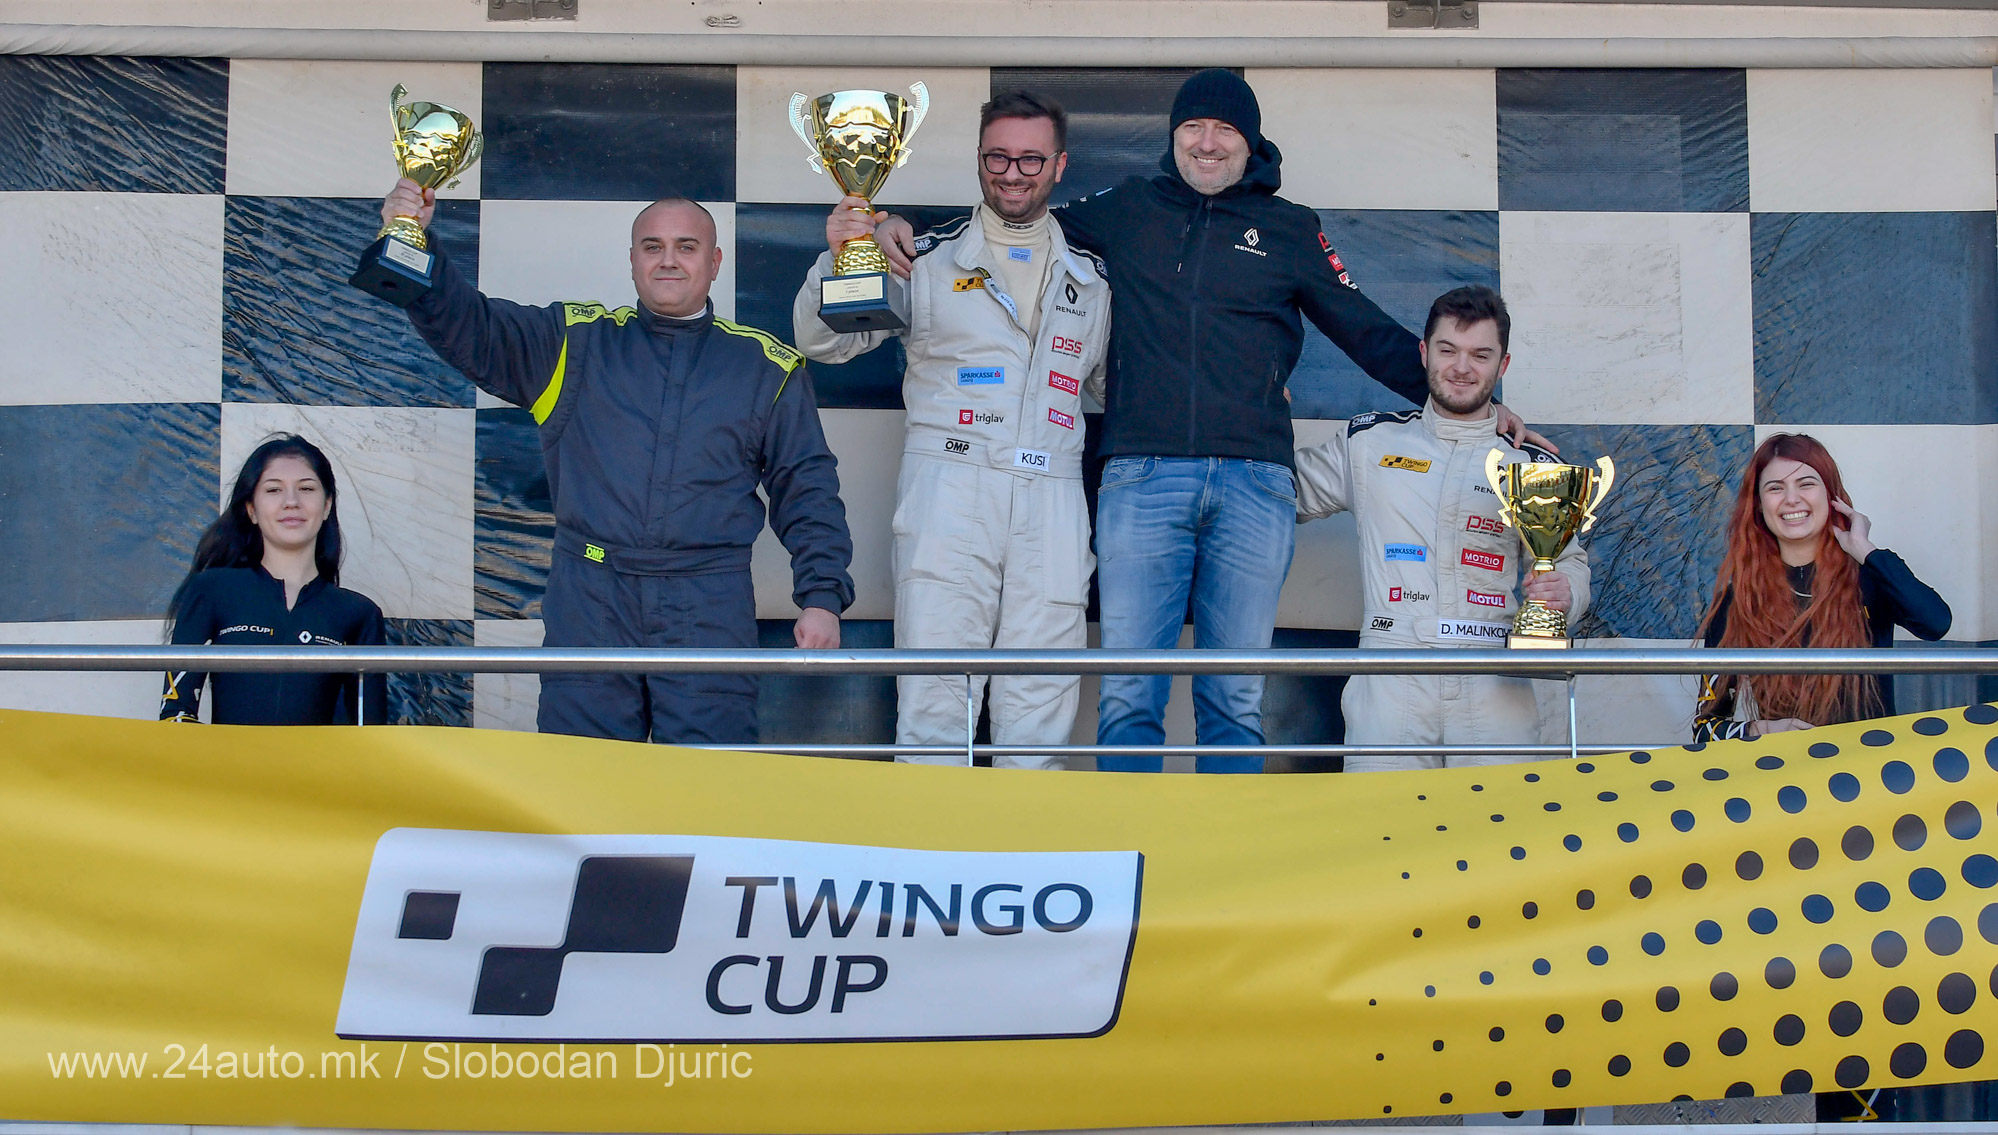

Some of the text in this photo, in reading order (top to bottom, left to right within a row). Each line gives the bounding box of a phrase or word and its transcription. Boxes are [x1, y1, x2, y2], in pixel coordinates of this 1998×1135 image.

[1234, 244, 1268, 257] RENAULT
[571, 307, 596, 318] OMP
[1055, 305, 1087, 318] RENAULT
[768, 345, 792, 362] OMP
[1052, 374, 1077, 390] MOTRIO
[975, 413, 1004, 425] triglav
[1050, 410, 1073, 428] MOTUL
[1352, 414, 1376, 426] OMP
[945, 440, 970, 454] OMP
[1021, 452, 1046, 467] KUSI
[1404, 458, 1428, 467] TWINGO
[585, 546, 605, 561] OMP
[1386, 547, 1416, 556] SPARKASSE
[1464, 552, 1500, 566] MOTRIO
[1403, 590, 1430, 602] triglav
[1469, 592, 1504, 606] MOTUL
[249, 625, 271, 634] CUP
[1371, 619, 1394, 630] OMP
[1441, 623, 1453, 635] D.
[724, 875, 1094, 939] TWINGO
[705, 953, 889, 1016] CUP
